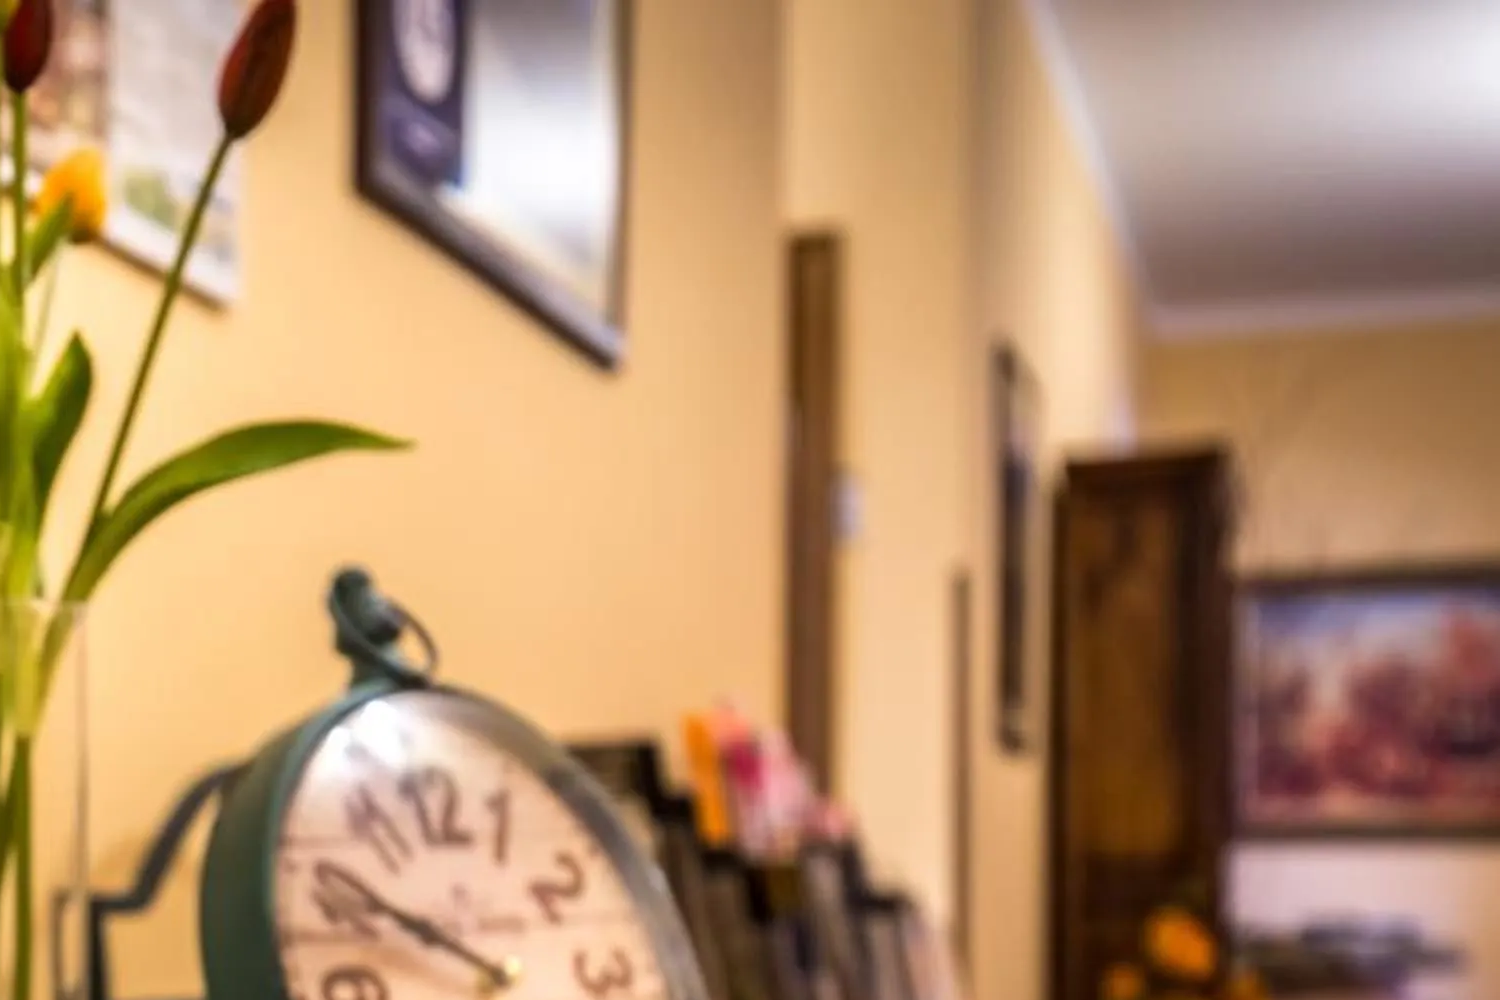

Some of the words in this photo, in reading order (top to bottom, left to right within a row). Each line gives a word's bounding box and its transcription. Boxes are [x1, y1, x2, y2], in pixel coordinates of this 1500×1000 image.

[398, 765, 474, 848] 12
[486, 789, 512, 864] 1
[528, 850, 585, 923] 2
[573, 945, 633, 998] 3
